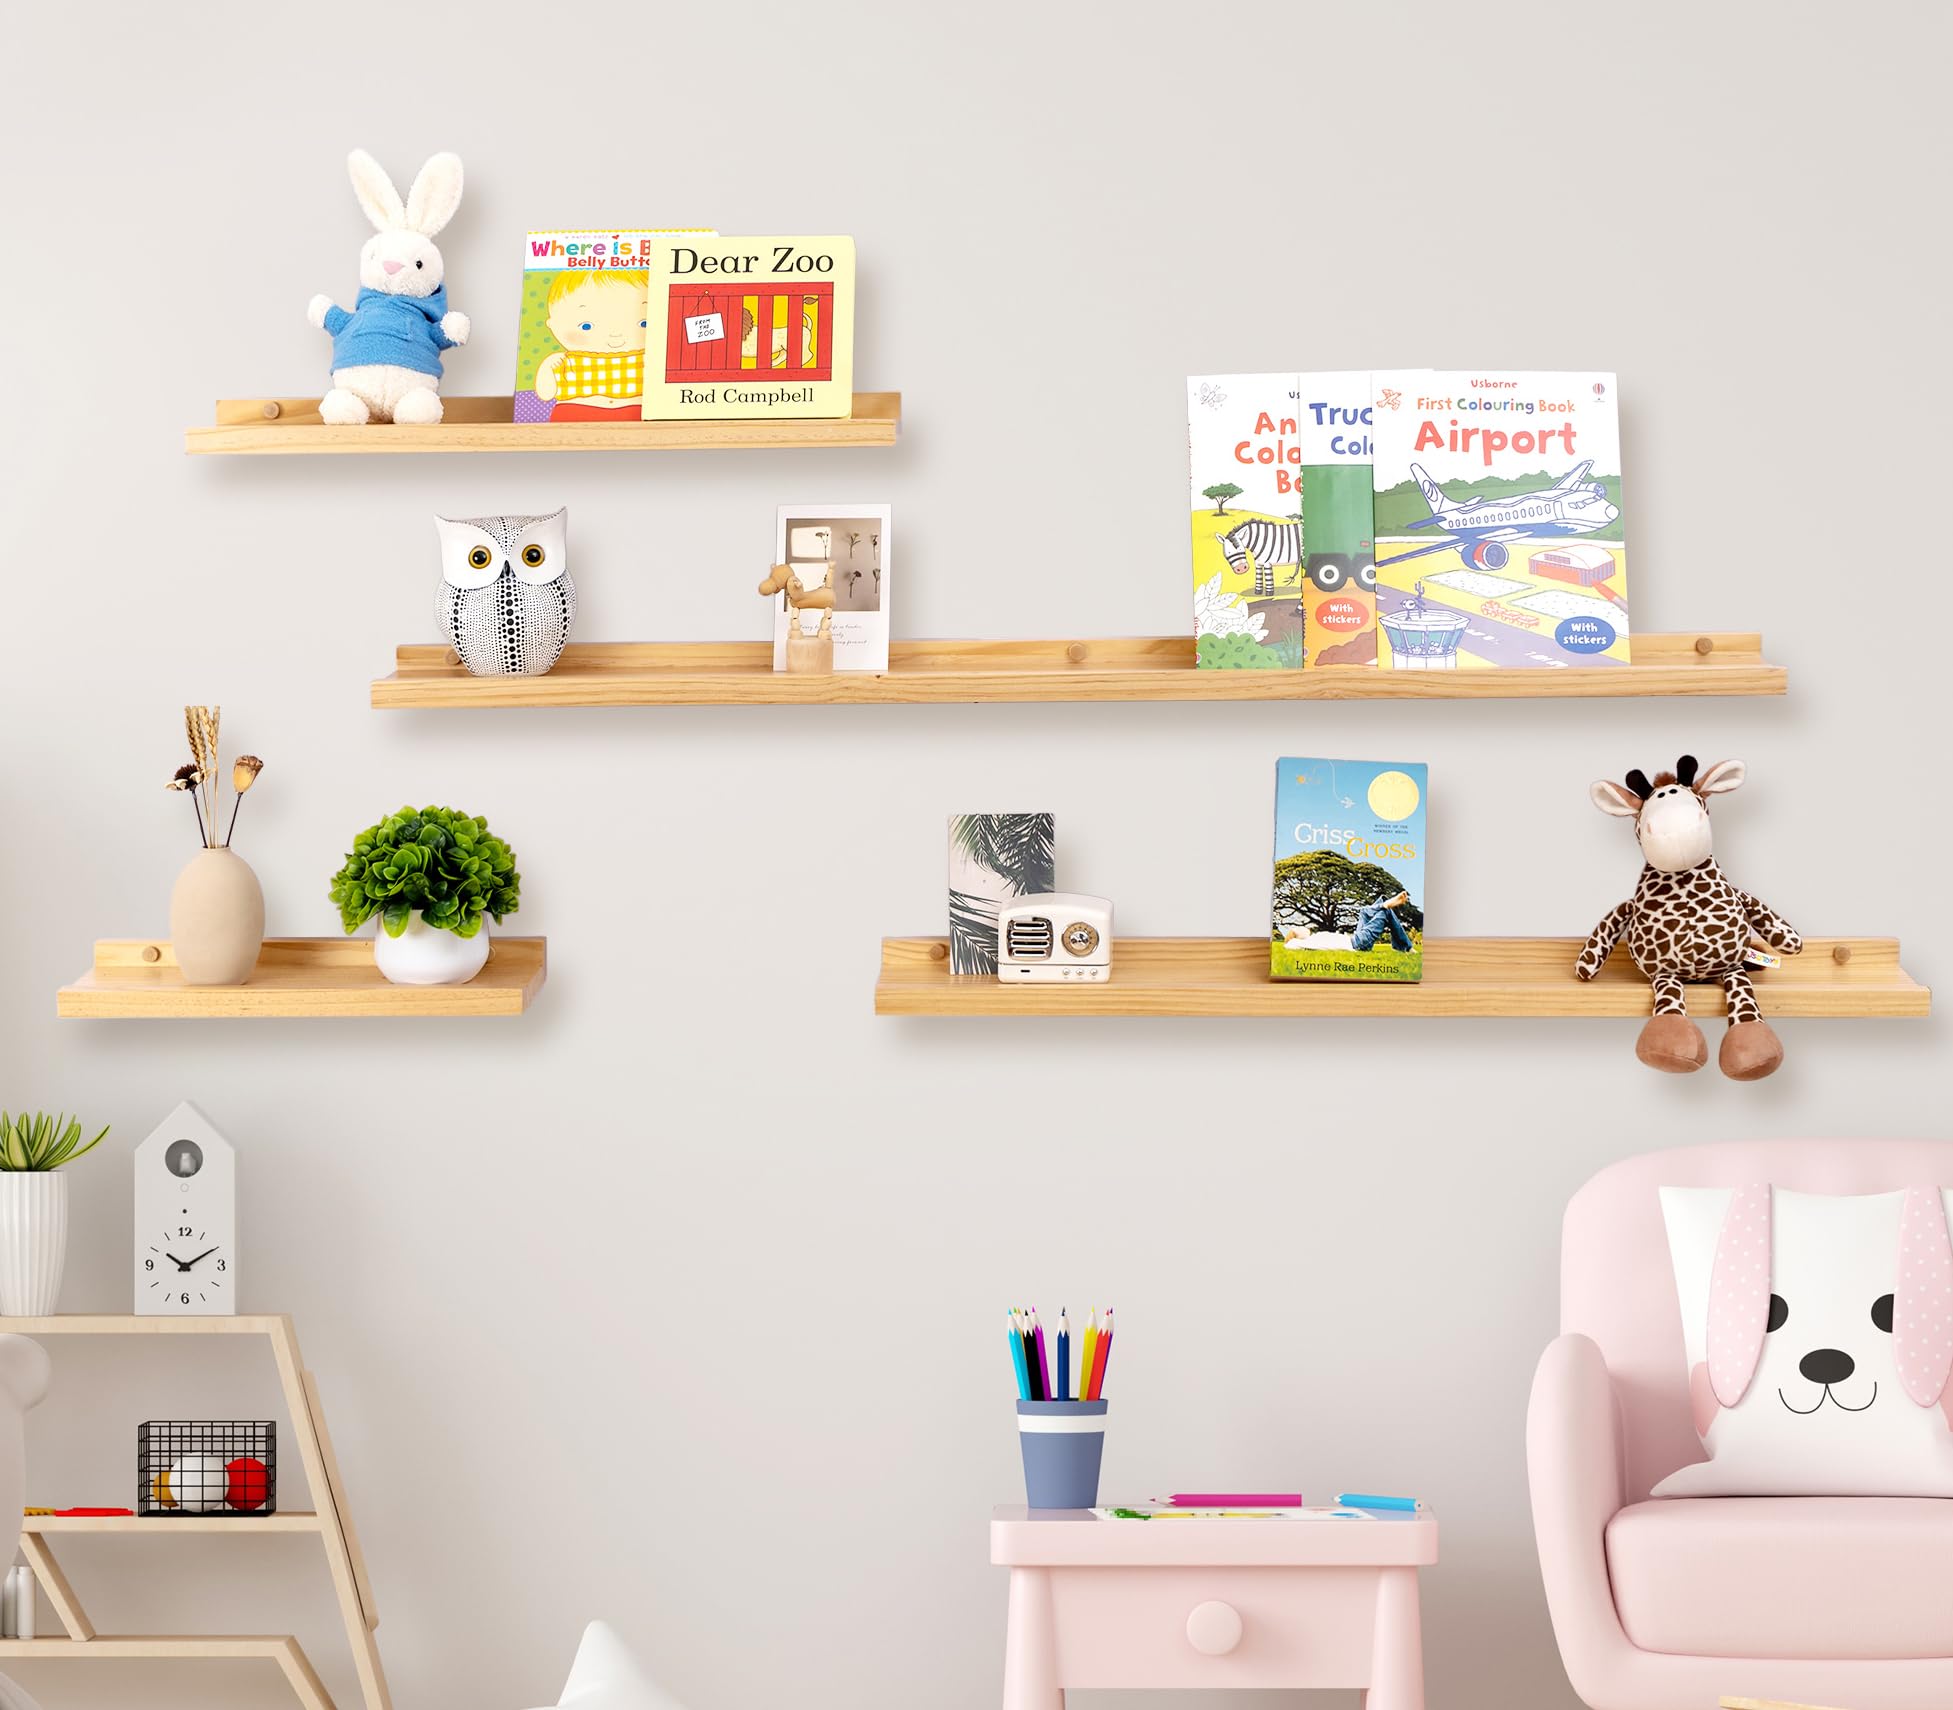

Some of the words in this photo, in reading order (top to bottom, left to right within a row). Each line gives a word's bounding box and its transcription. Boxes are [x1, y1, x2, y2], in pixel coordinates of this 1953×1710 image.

[531, 239, 606, 257] Where
[613, 239, 633, 255] is
[567, 255, 606, 270] Belly
[669, 248, 759, 274] Dear
[771, 247, 834, 273] Zoo
[697, 328, 715, 338] ZOO
[1470, 378, 1518, 389] Usborne
[679, 389, 716, 404] Rod
[723, 387, 814, 406] Campbell
[1416, 397, 1453, 411] First
[1457, 398, 1535, 415] Colouring
[1538, 399, 1576, 413] Book
[1308, 402, 1373, 426] Truc
[1253, 411, 1297, 435] An
[1330, 435, 1374, 456] Col
[1413, 418, 1577, 467] Airport
[1234, 439, 1302, 465] Colo
[1329, 603, 1354, 613] With
[1322, 614, 1361, 624] stickers
[1570, 622, 1598, 633] With
[1563, 634, 1607, 645] stickers
[1294, 822, 1355, 845] Criss
[1345, 837, 1417, 859] Cross
[1295, 960, 1331, 973] Lynne
[1334, 961, 1355, 972] Rae
[1358, 962, 1400, 974] Perkins
[178, 1226, 193, 1237] 12
[145, 1258, 154, 1272] 9
[217, 1258, 226, 1272] 3
[180, 1292, 190, 1305] 6
